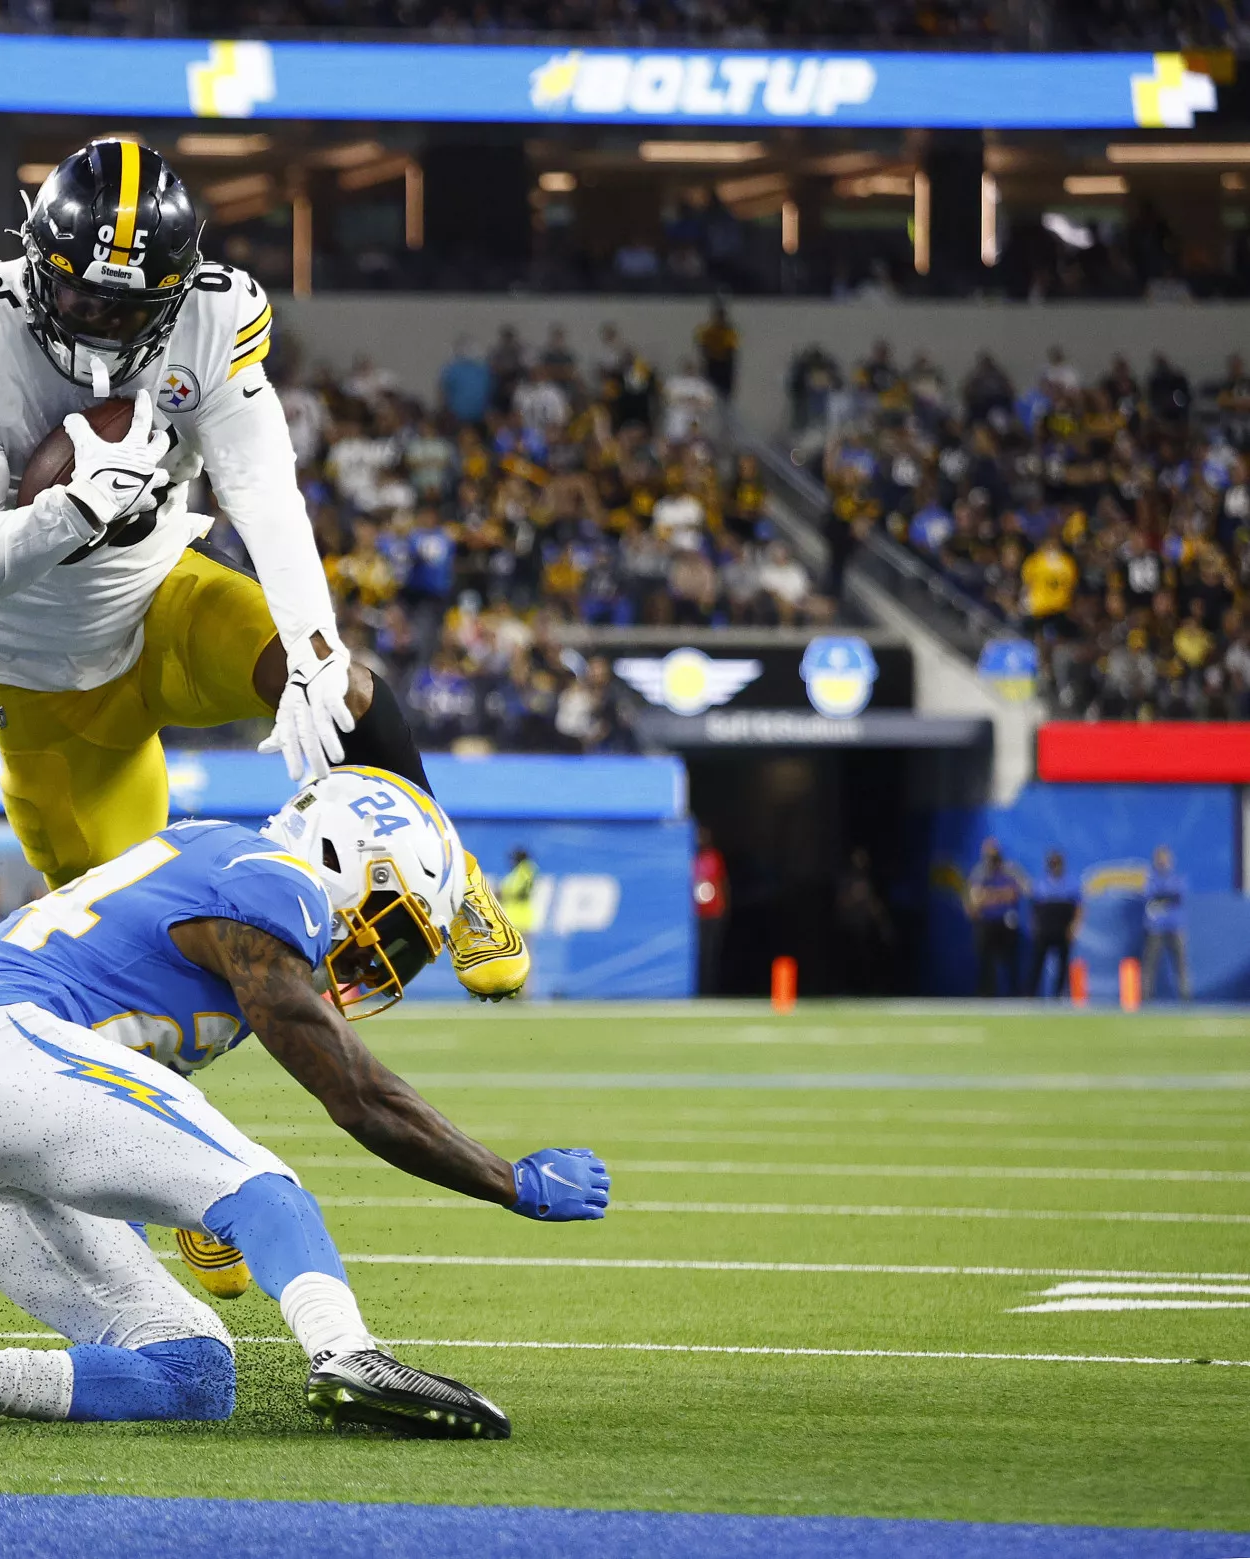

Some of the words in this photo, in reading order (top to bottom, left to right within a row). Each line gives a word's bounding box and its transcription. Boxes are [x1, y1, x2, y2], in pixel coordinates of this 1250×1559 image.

[93, 225, 148, 266] 85
[101, 265, 132, 279] Steelers
[348, 791, 411, 838] 24
